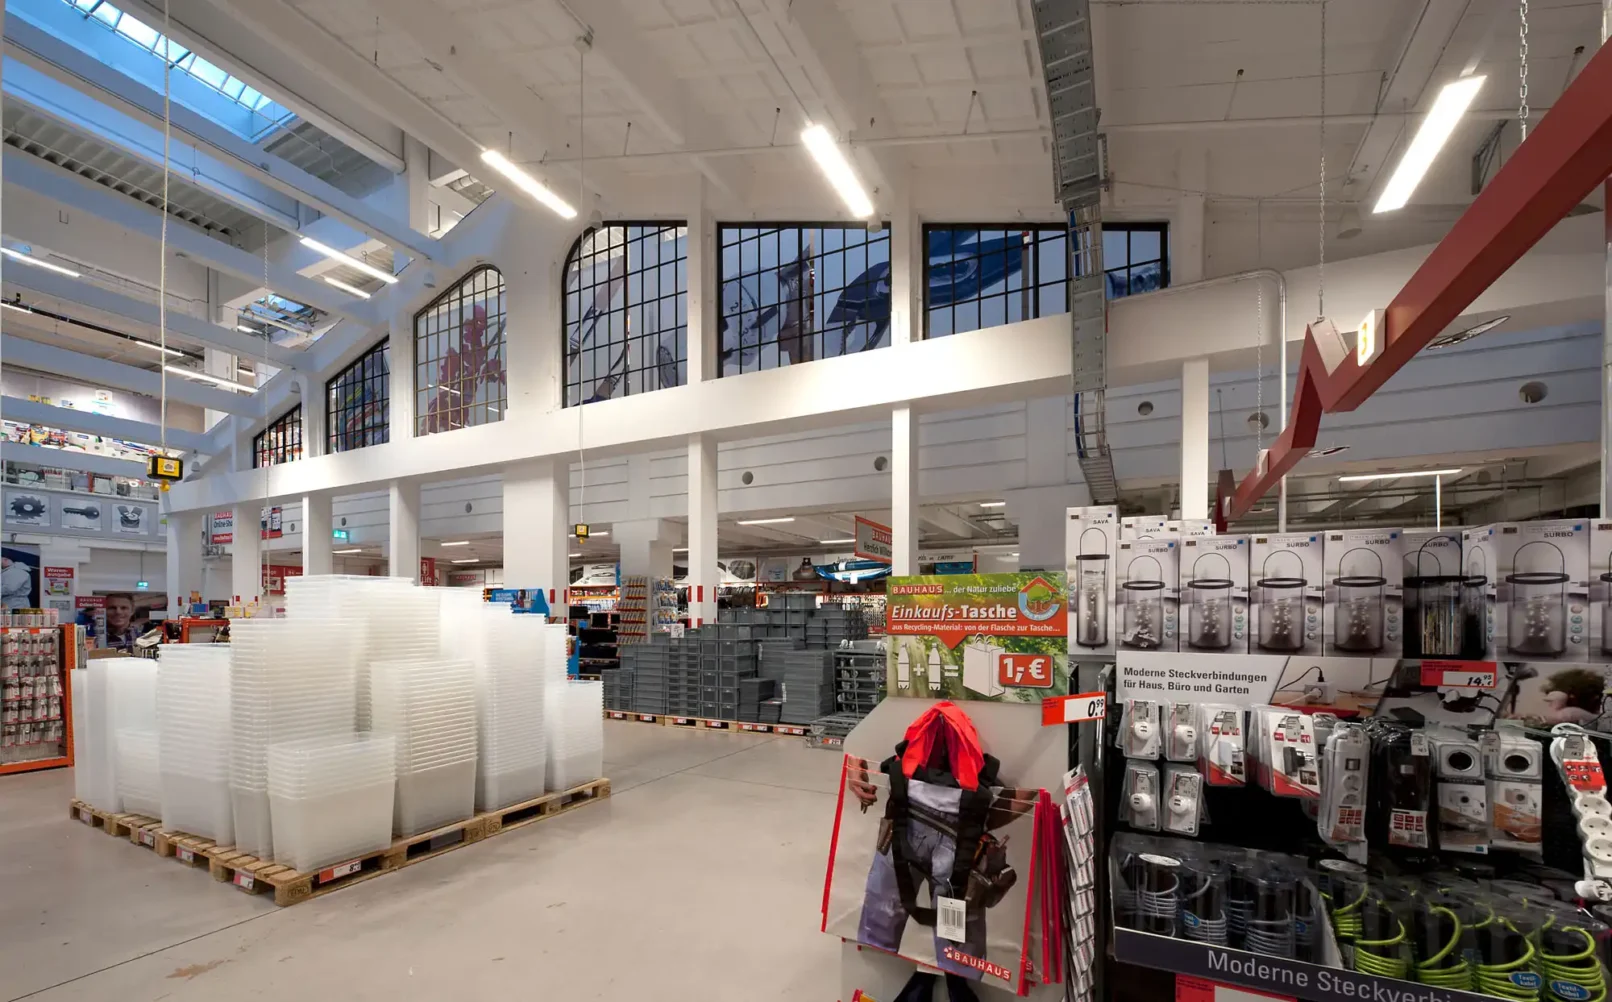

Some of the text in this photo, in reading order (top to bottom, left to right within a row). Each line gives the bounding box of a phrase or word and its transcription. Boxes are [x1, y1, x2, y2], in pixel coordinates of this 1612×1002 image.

[872, 529, 892, 545] BAUHAU
[892, 586, 943, 594] BAUHAUS
[967, 585, 987, 593] Natur
[989, 585, 1016, 593] zuliebe
[892, 604, 1017, 621] Einkaufs-Tasche
[904, 624, 962, 632] Recycling-Material:
[978, 624, 989, 632] der
[991, 624, 1015, 632] Flasche
[1029, 658, 1045, 680] €
[1123, 667, 1267, 683] Moderne Steckverbindungen
[1123, 679, 1250, 694] für Haus, Büro und Garten
[954, 952, 1010, 979] BAUHAUS
[1207, 950, 1309, 987] Moderne
[1316, 971, 1452, 1002] Steckve
[1557, 983, 1580, 992] Textil-
[1559, 988, 1579, 998] kabel
